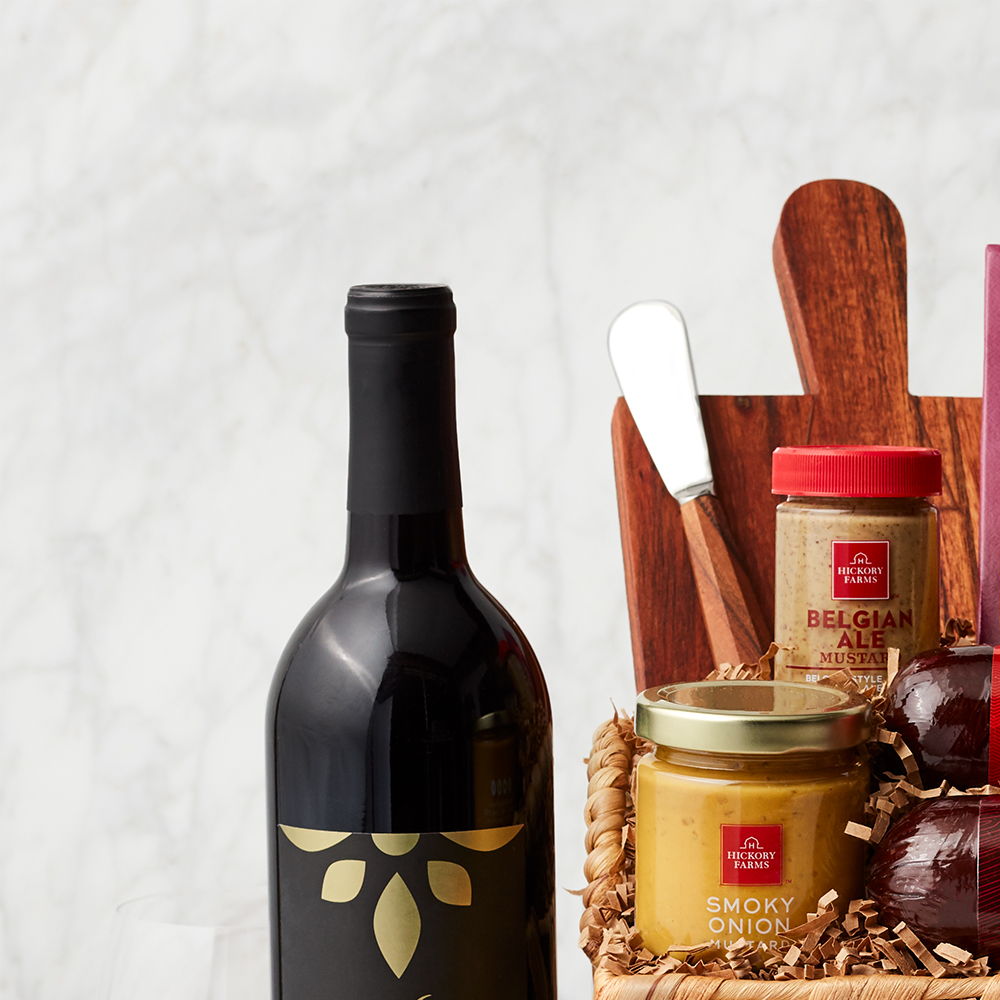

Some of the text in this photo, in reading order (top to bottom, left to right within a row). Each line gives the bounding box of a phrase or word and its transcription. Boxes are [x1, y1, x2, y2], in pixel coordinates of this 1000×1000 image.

[838, 566, 883, 575] HICKORY
[844, 576, 878, 584] FARMS
[807, 609, 913, 629] BELGIAN
[837, 631, 885, 649] ALE
[820, 652, 888, 664] MUSTAR
[727, 851, 776, 860] HICKORY
[734, 861, 770, 869] FARMS
[706, 896, 795, 914] SMOKY
[708, 917, 789, 934] ONION
